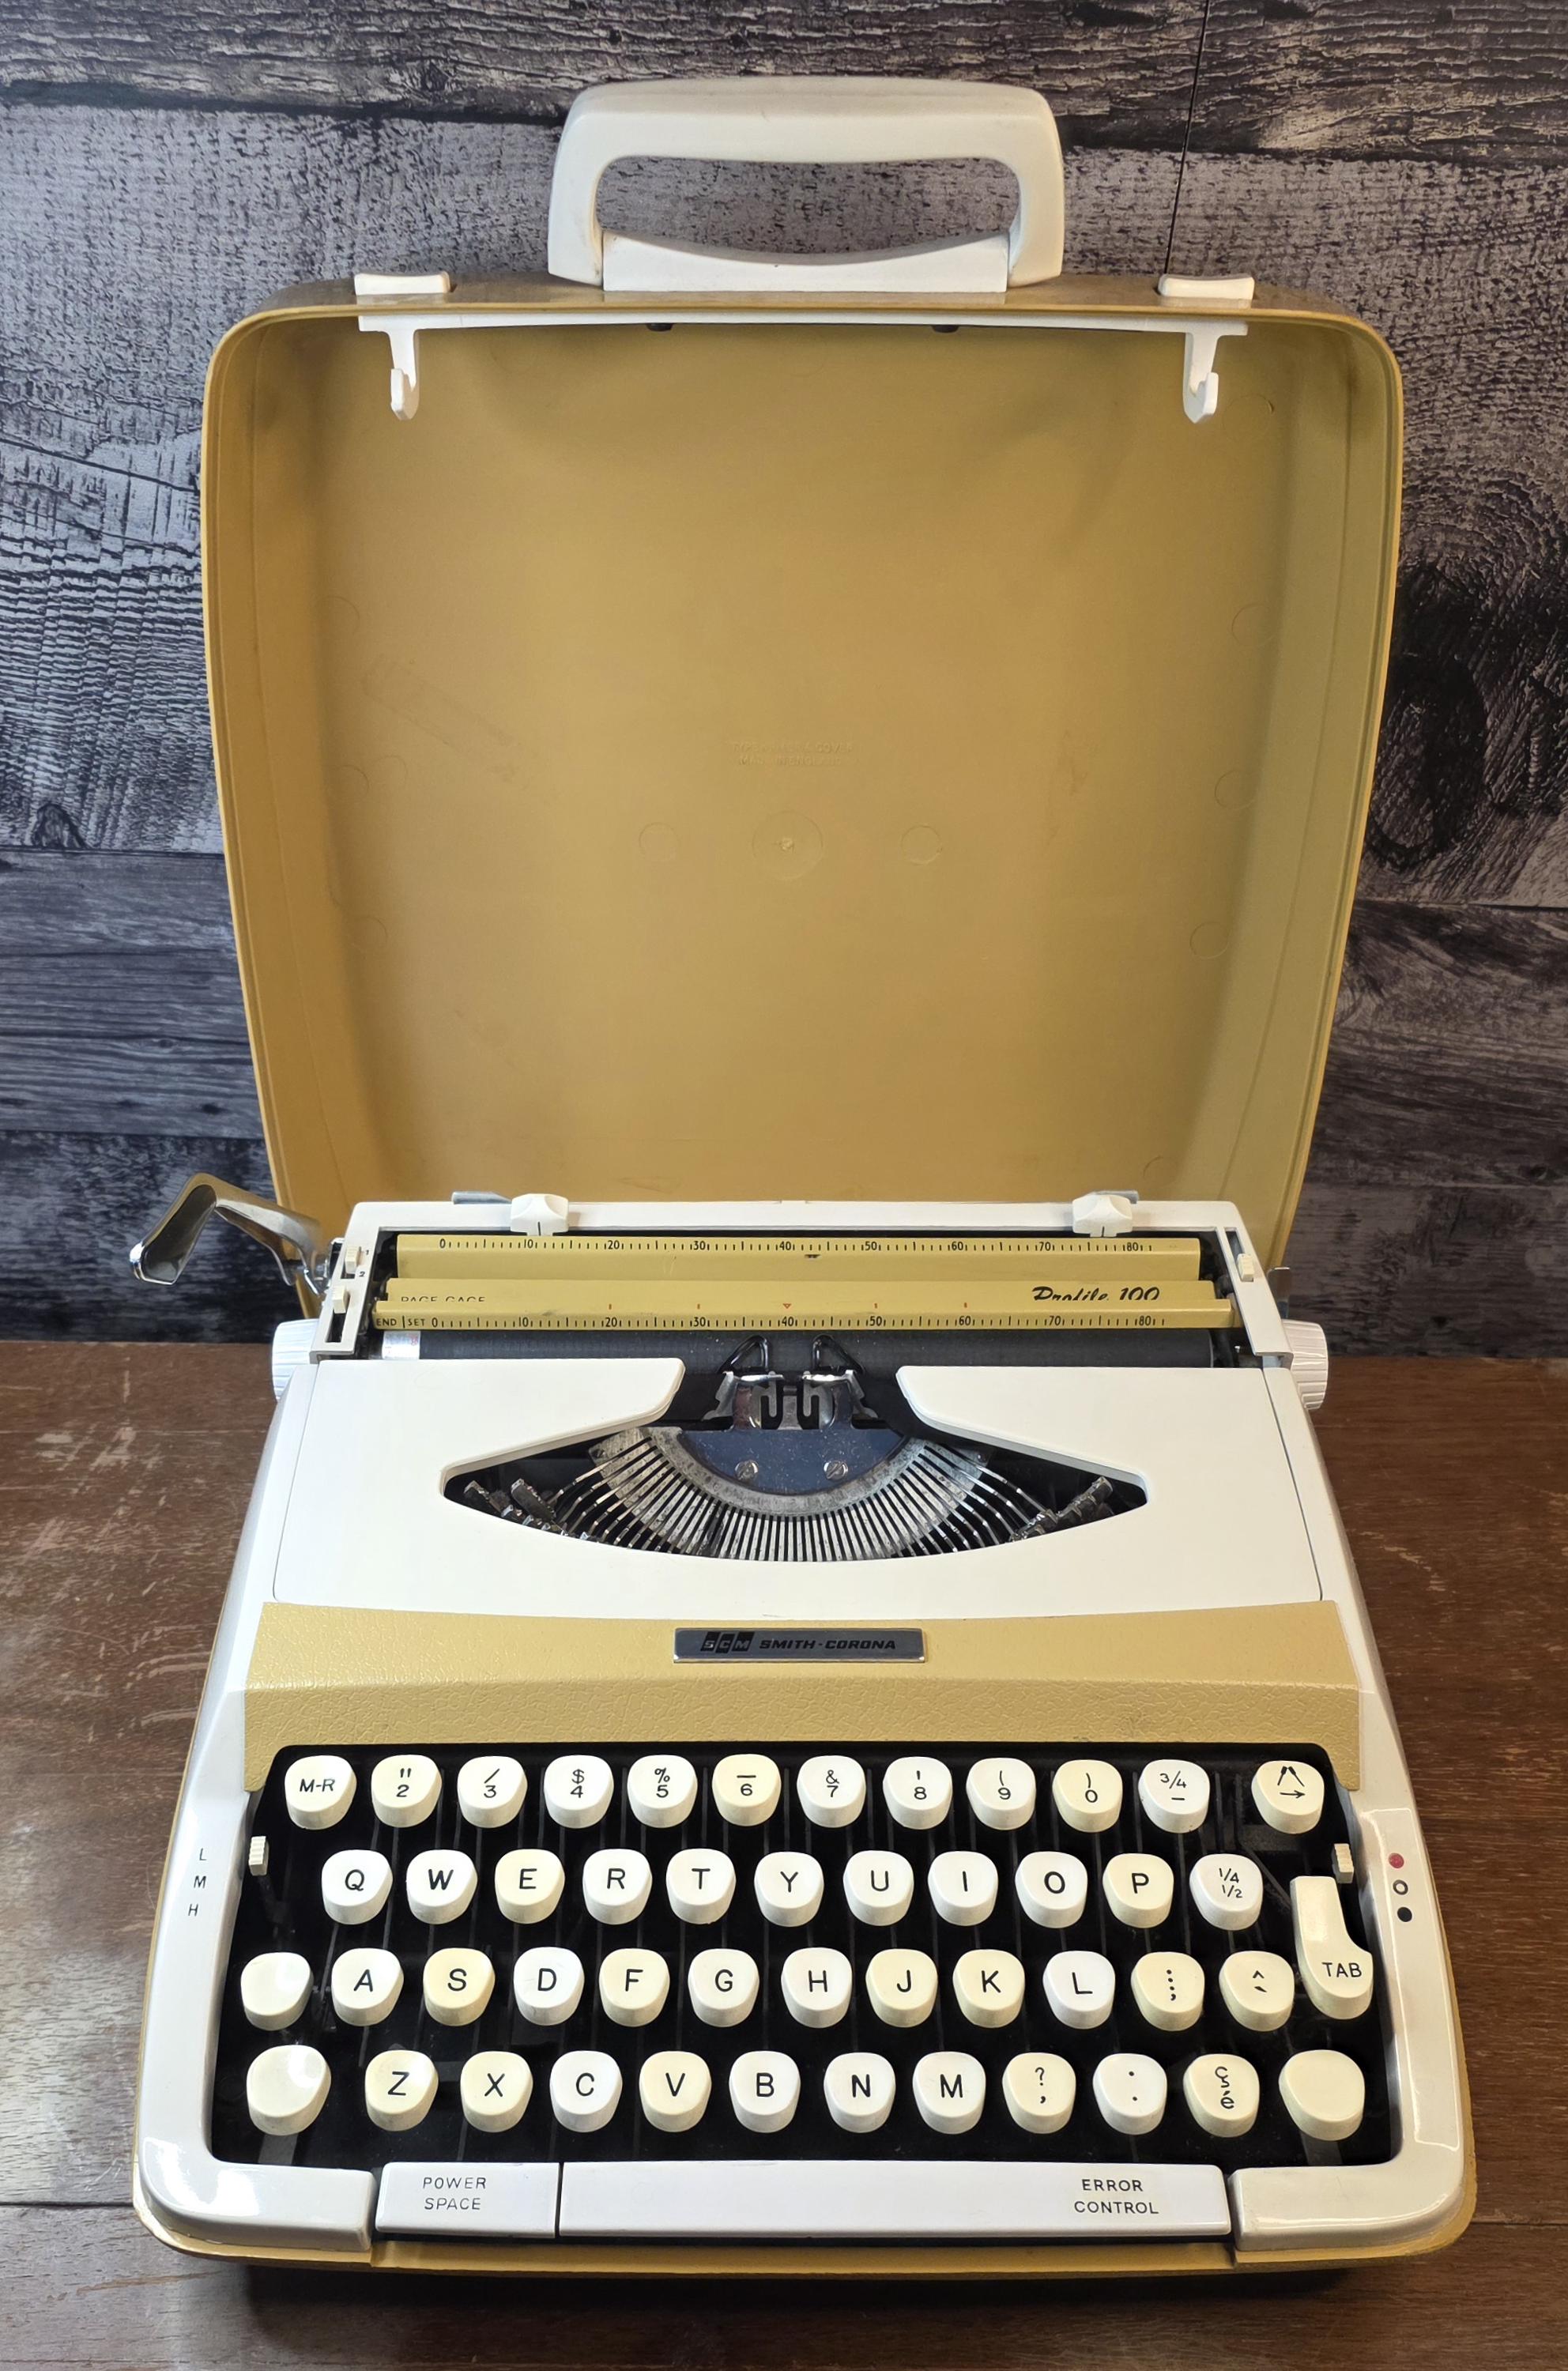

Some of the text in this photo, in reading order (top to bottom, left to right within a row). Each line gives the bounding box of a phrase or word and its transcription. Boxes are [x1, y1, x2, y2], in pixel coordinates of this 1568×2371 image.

[439, 1238, 1140, 1252] 0 10 20 30 40 50 60 70 80
[1119, 1286, 1160, 1301] 100
[376, 1315, 1152, 1328] END SET 0 10 20 30 40 50 60 70 80
[702, 1637, 752, 1651] SCM
[299, 1778, 335, 1792] M-R
[571, 1768, 585, 1785] $
[825, 1770, 840, 1785] &
[396, 1784, 409, 1798] 2
[483, 1785, 497, 1799] 3
[570, 1785, 584, 1799] 4
[656, 1784, 669, 1799] 5
[740, 1783, 753, 1796] 6
[827, 1785, 839, 1798] 7
[914, 1786, 927, 1800] 8
[997, 1787, 1012, 1800] 9
[1084, 1789, 1099, 1804] 0
[199, 1848, 207, 1861] L
[194, 1875, 207, 1888] M
[345, 1868, 365, 1892] Q
[428, 1868, 454, 1890] W
[518, 1868, 537, 1890] E
[606, 1868, 626, 1890] R
[691, 1868, 711, 1890] T
[779, 1871, 799, 1893] Y
[870, 1869, 889, 1892] U
[962, 1871, 968, 1892] I
[1043, 1871, 1066, 1894] O
[1131, 1872, 1150, 1894] P
[188, 1904, 199, 1917] H
[353, 1969, 374, 1992] A
[447, 1968, 467, 1992] S
[537, 1967, 557, 1992] D
[624, 1968, 644, 1992] F
[714, 1969, 733, 1992] G
[1321, 1962, 1363, 1978] TAB
[808, 1970, 828, 1992] H
[896, 1970, 912, 1993] J
[981, 1970, 1001, 1993] K
[1072, 1972, 1093, 1995] L
[387, 2071, 409, 2096] Z
[484, 2072, 505, 2098] X
[575, 2072, 595, 2097] C
[665, 2072, 686, 2098] V
[756, 2072, 775, 2098] B
[851, 2074, 871, 2098] N
[940, 2073, 963, 2098] M
[423, 2177, 486, 2189] POWER
[1081, 2178, 1144, 2192] ERROR
[424, 2197, 481, 2211] SPACE
[1074, 2200, 1159, 2215] CONTROL
